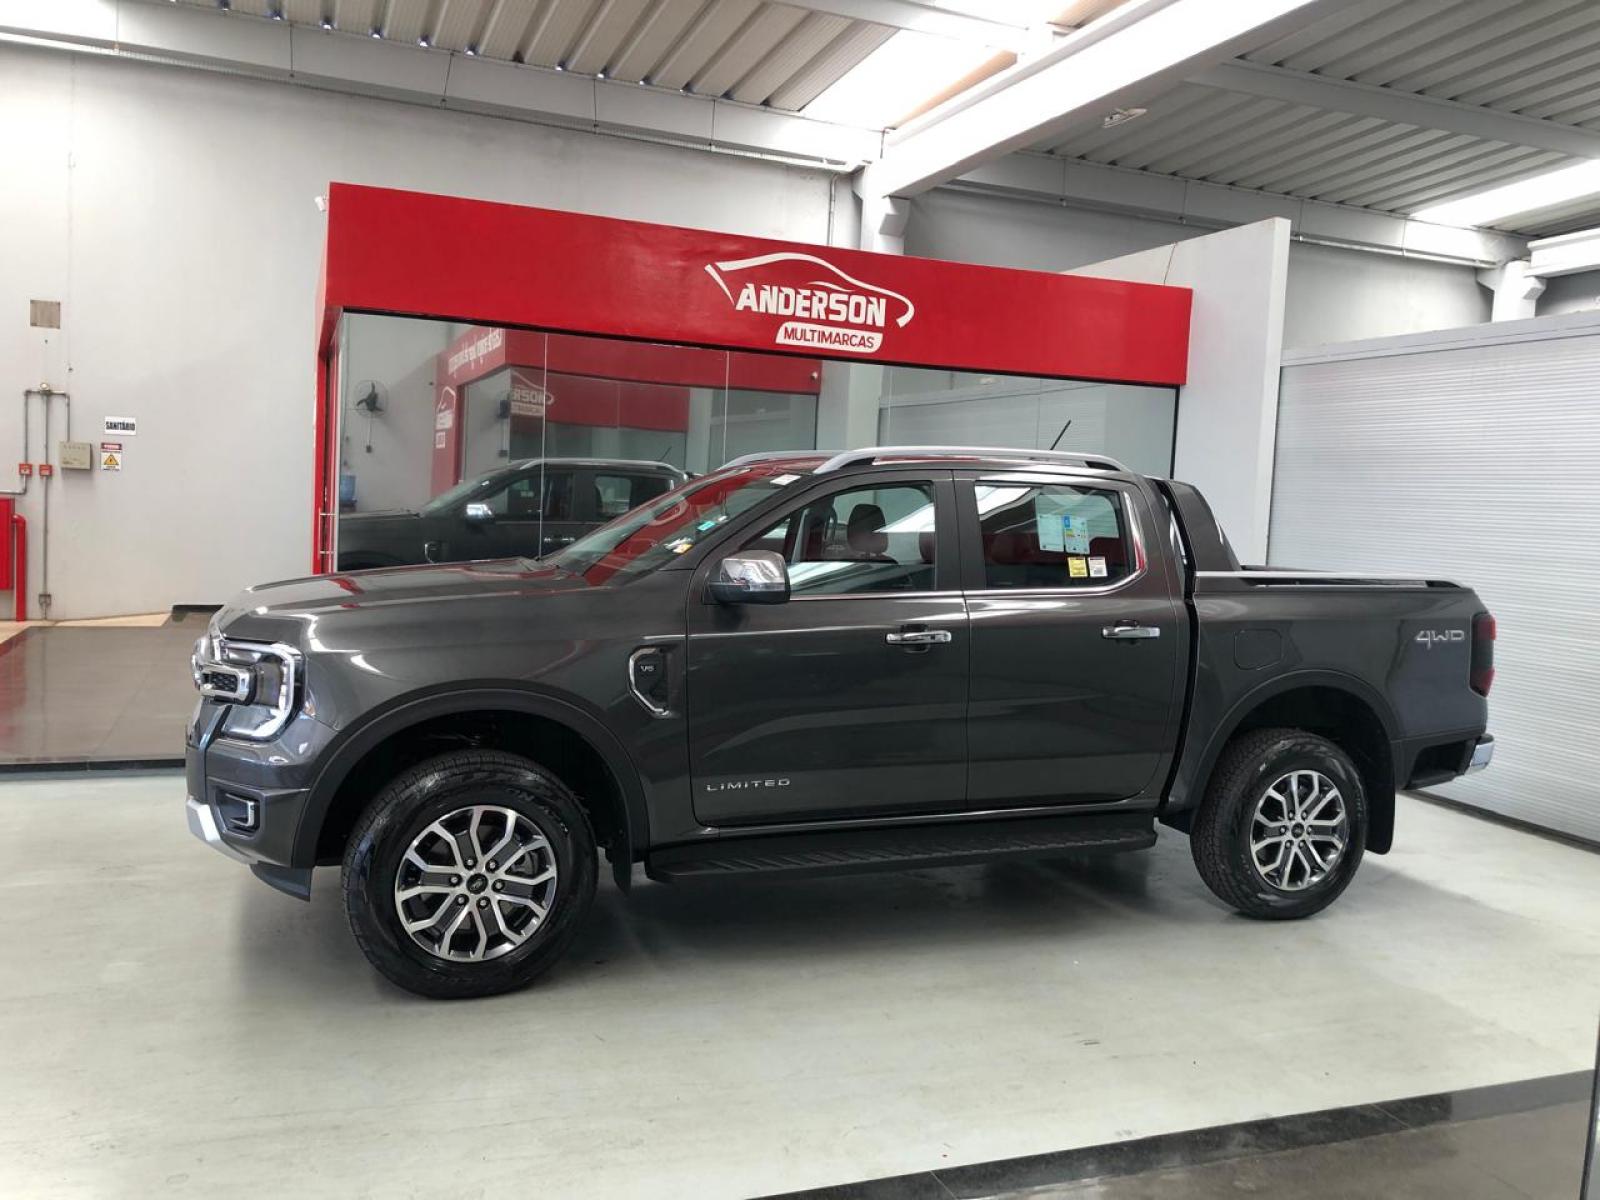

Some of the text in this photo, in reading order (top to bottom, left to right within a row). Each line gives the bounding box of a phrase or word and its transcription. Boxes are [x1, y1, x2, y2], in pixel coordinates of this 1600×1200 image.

[735, 283, 886, 328] ANDERSON
[783, 326, 875, 349] MULTIMARCAS
[1414, 629, 1465, 650] 4WD
[706, 778, 791, 791] LIMITED
